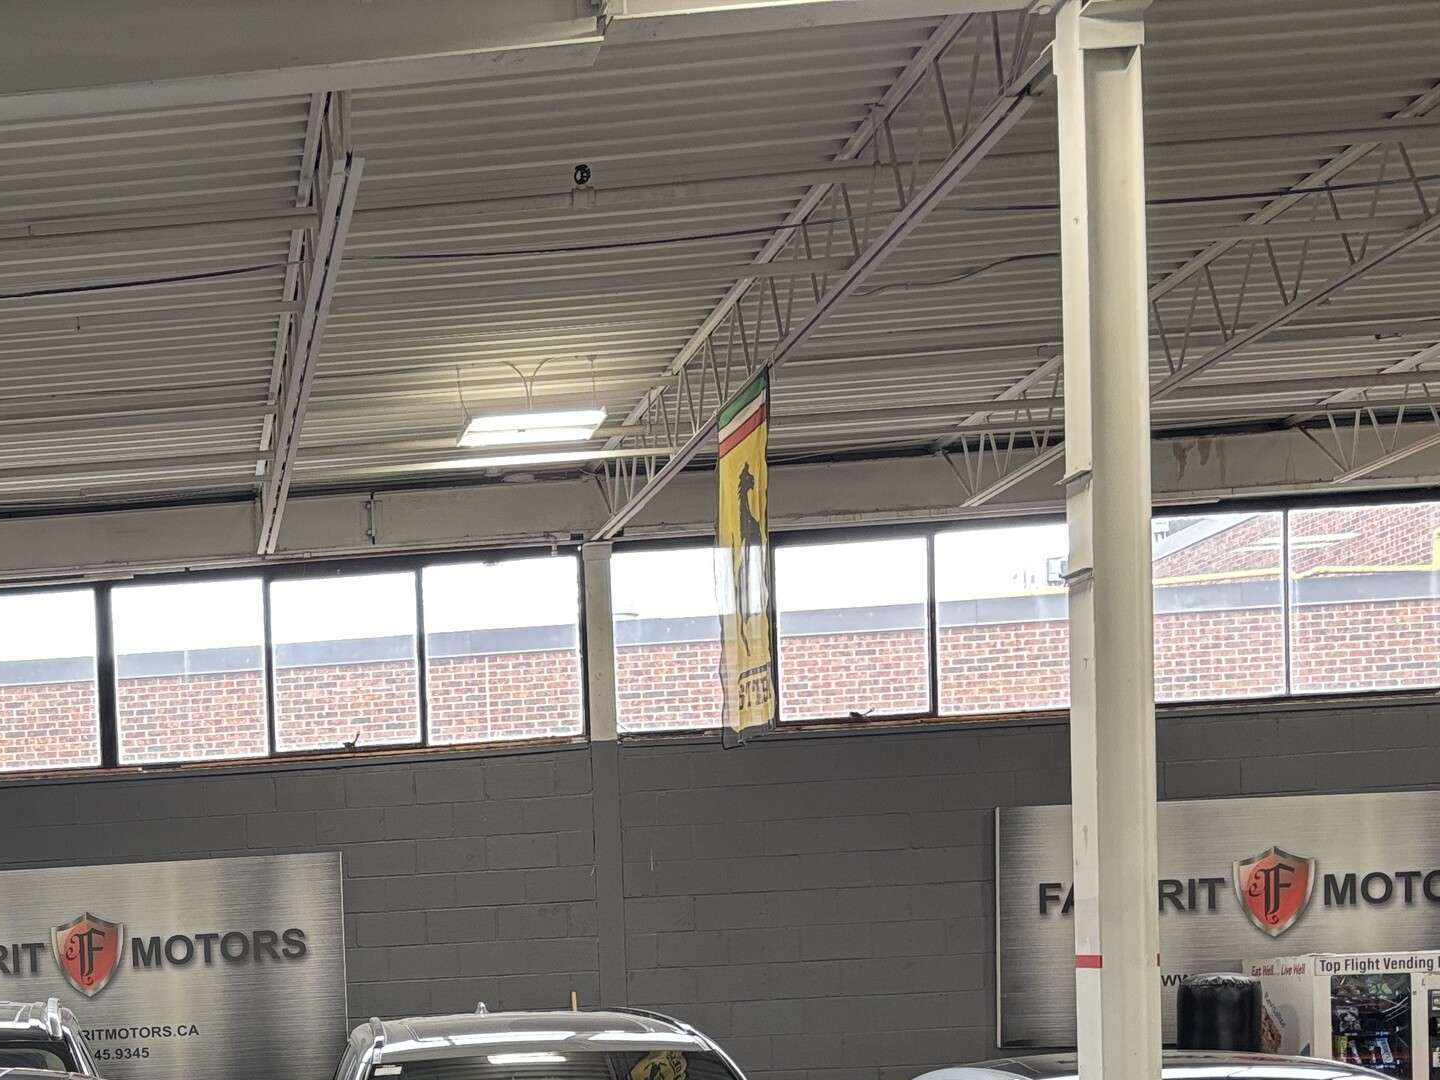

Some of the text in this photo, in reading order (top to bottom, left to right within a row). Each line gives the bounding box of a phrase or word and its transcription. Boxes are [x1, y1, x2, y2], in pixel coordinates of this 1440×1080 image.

[1039, 876, 1224, 915] FRIT
[132, 928, 307, 968] MOTORS
[1320, 960, 1340, 974] Top
[1344, 957, 1380, 973] Flight
[1383, 956, 1434, 971] Vending
[79, 1024, 199, 1041] RITMOTORS.CA
